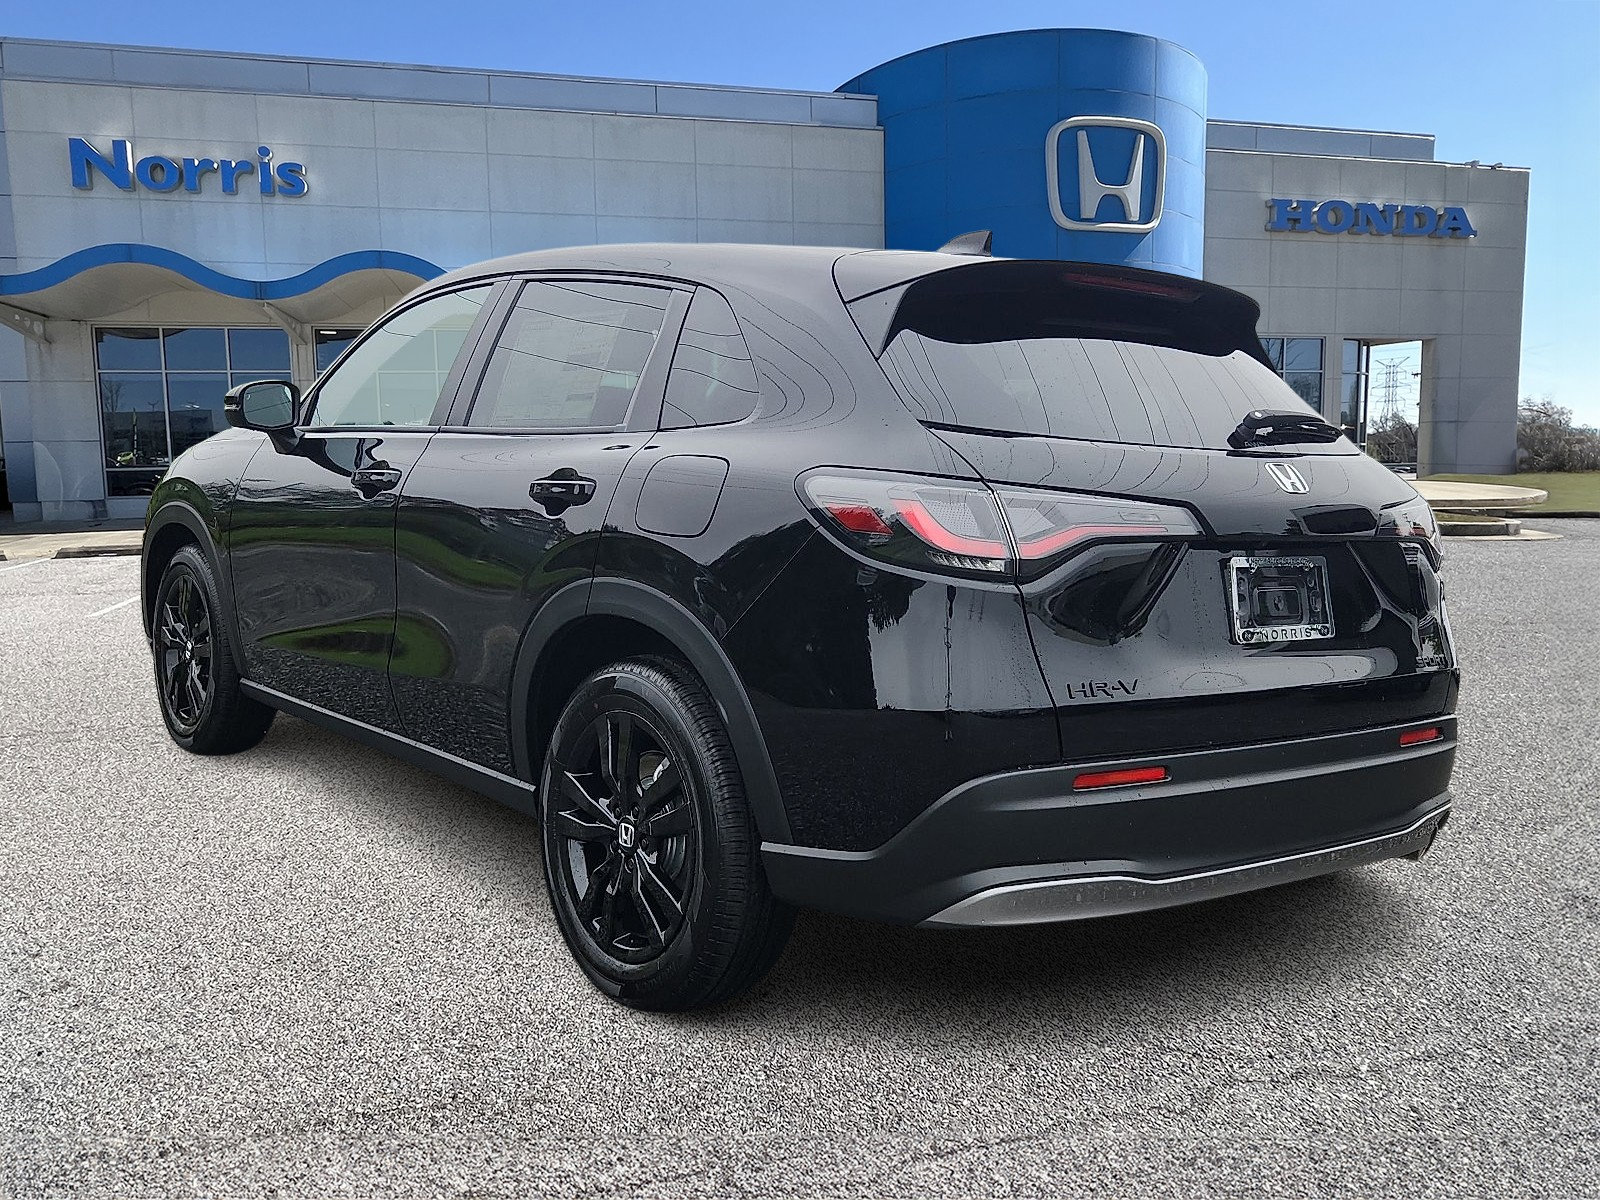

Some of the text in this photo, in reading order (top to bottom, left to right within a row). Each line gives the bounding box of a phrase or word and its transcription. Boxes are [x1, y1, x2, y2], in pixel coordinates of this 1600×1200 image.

[68, 137, 309, 197] Norris
[1266, 198, 1477, 239] HONDA
[1261, 626, 1313, 640] NORRIS
[1415, 653, 1446, 668] SPORT
[1066, 678, 1139, 700] HR-V
